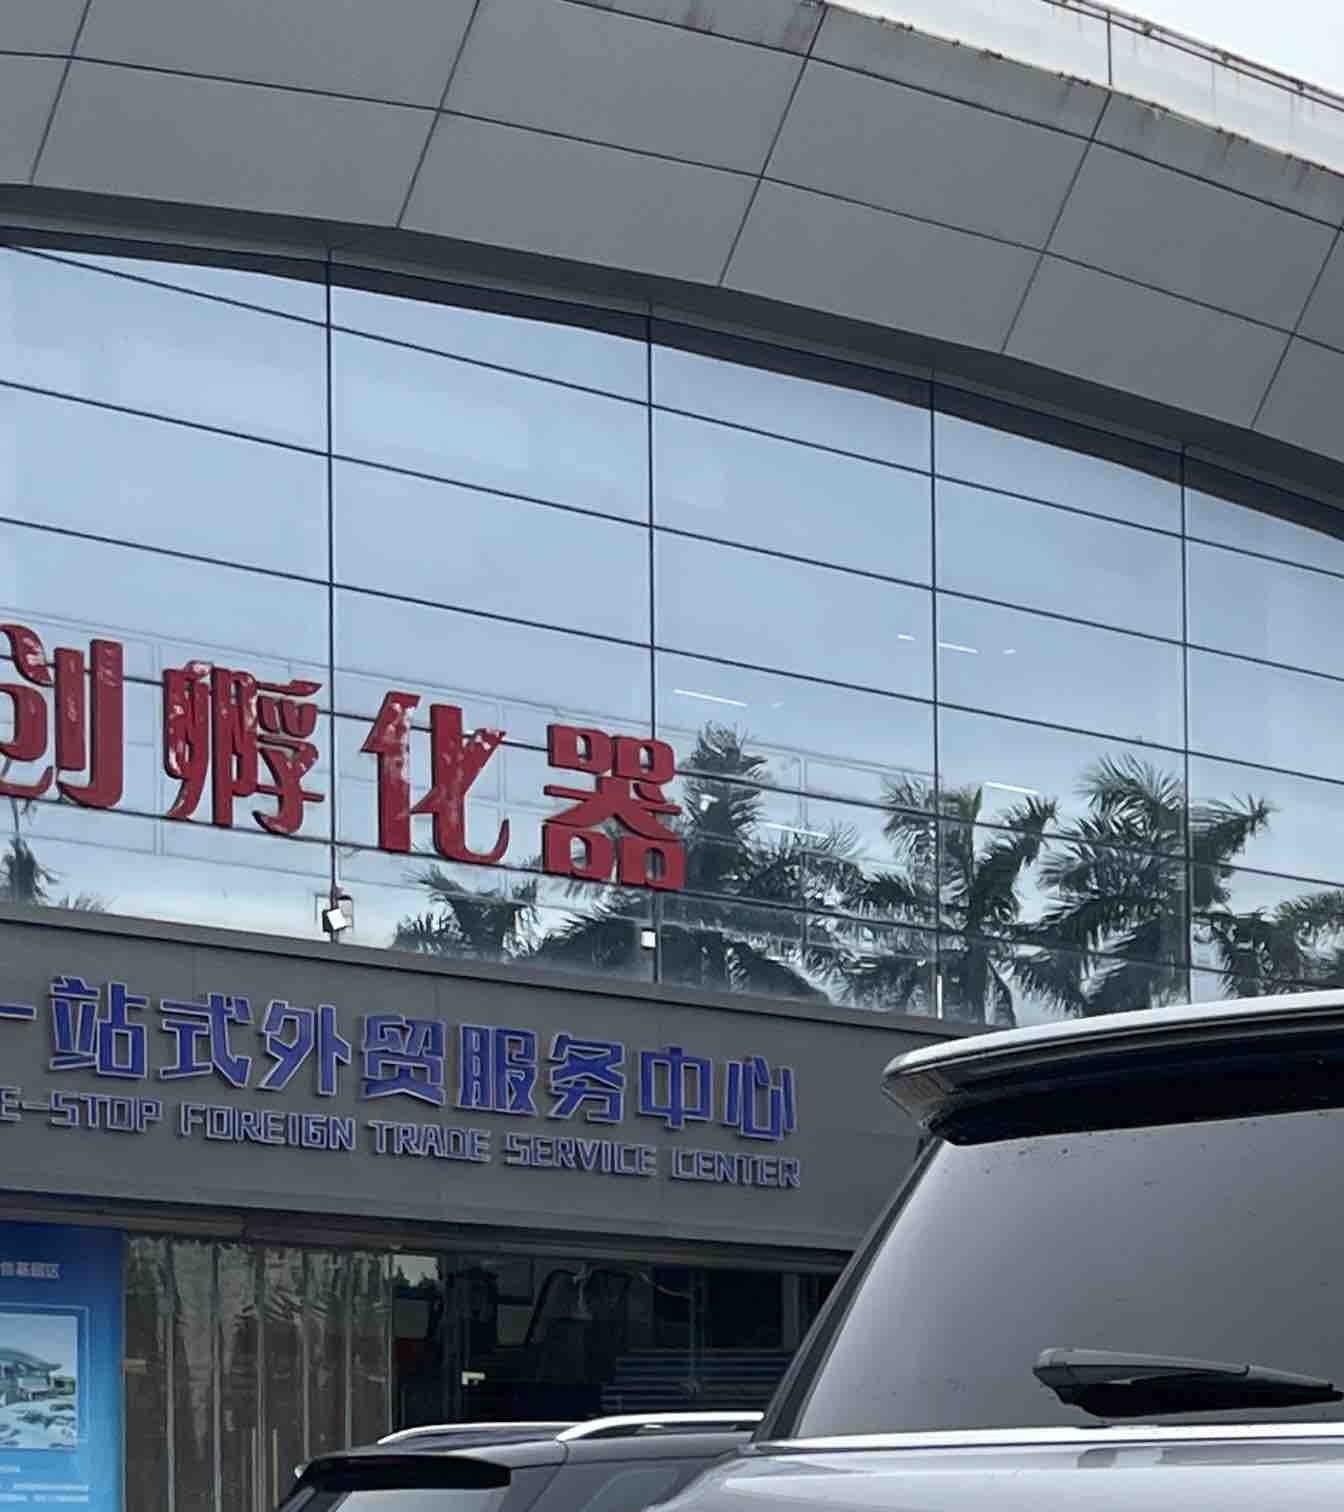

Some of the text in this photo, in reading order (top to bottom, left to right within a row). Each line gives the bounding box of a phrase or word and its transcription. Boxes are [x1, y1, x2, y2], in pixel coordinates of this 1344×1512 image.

[0, 623, 685, 891] 创孵化器
[180, 1103, 356, 1151] FOREIGN
[367, 1119, 492, 1162] TRADE
[505, 1133, 657, 1176] SERVICE
[672, 1147, 801, 1188] CENTER
